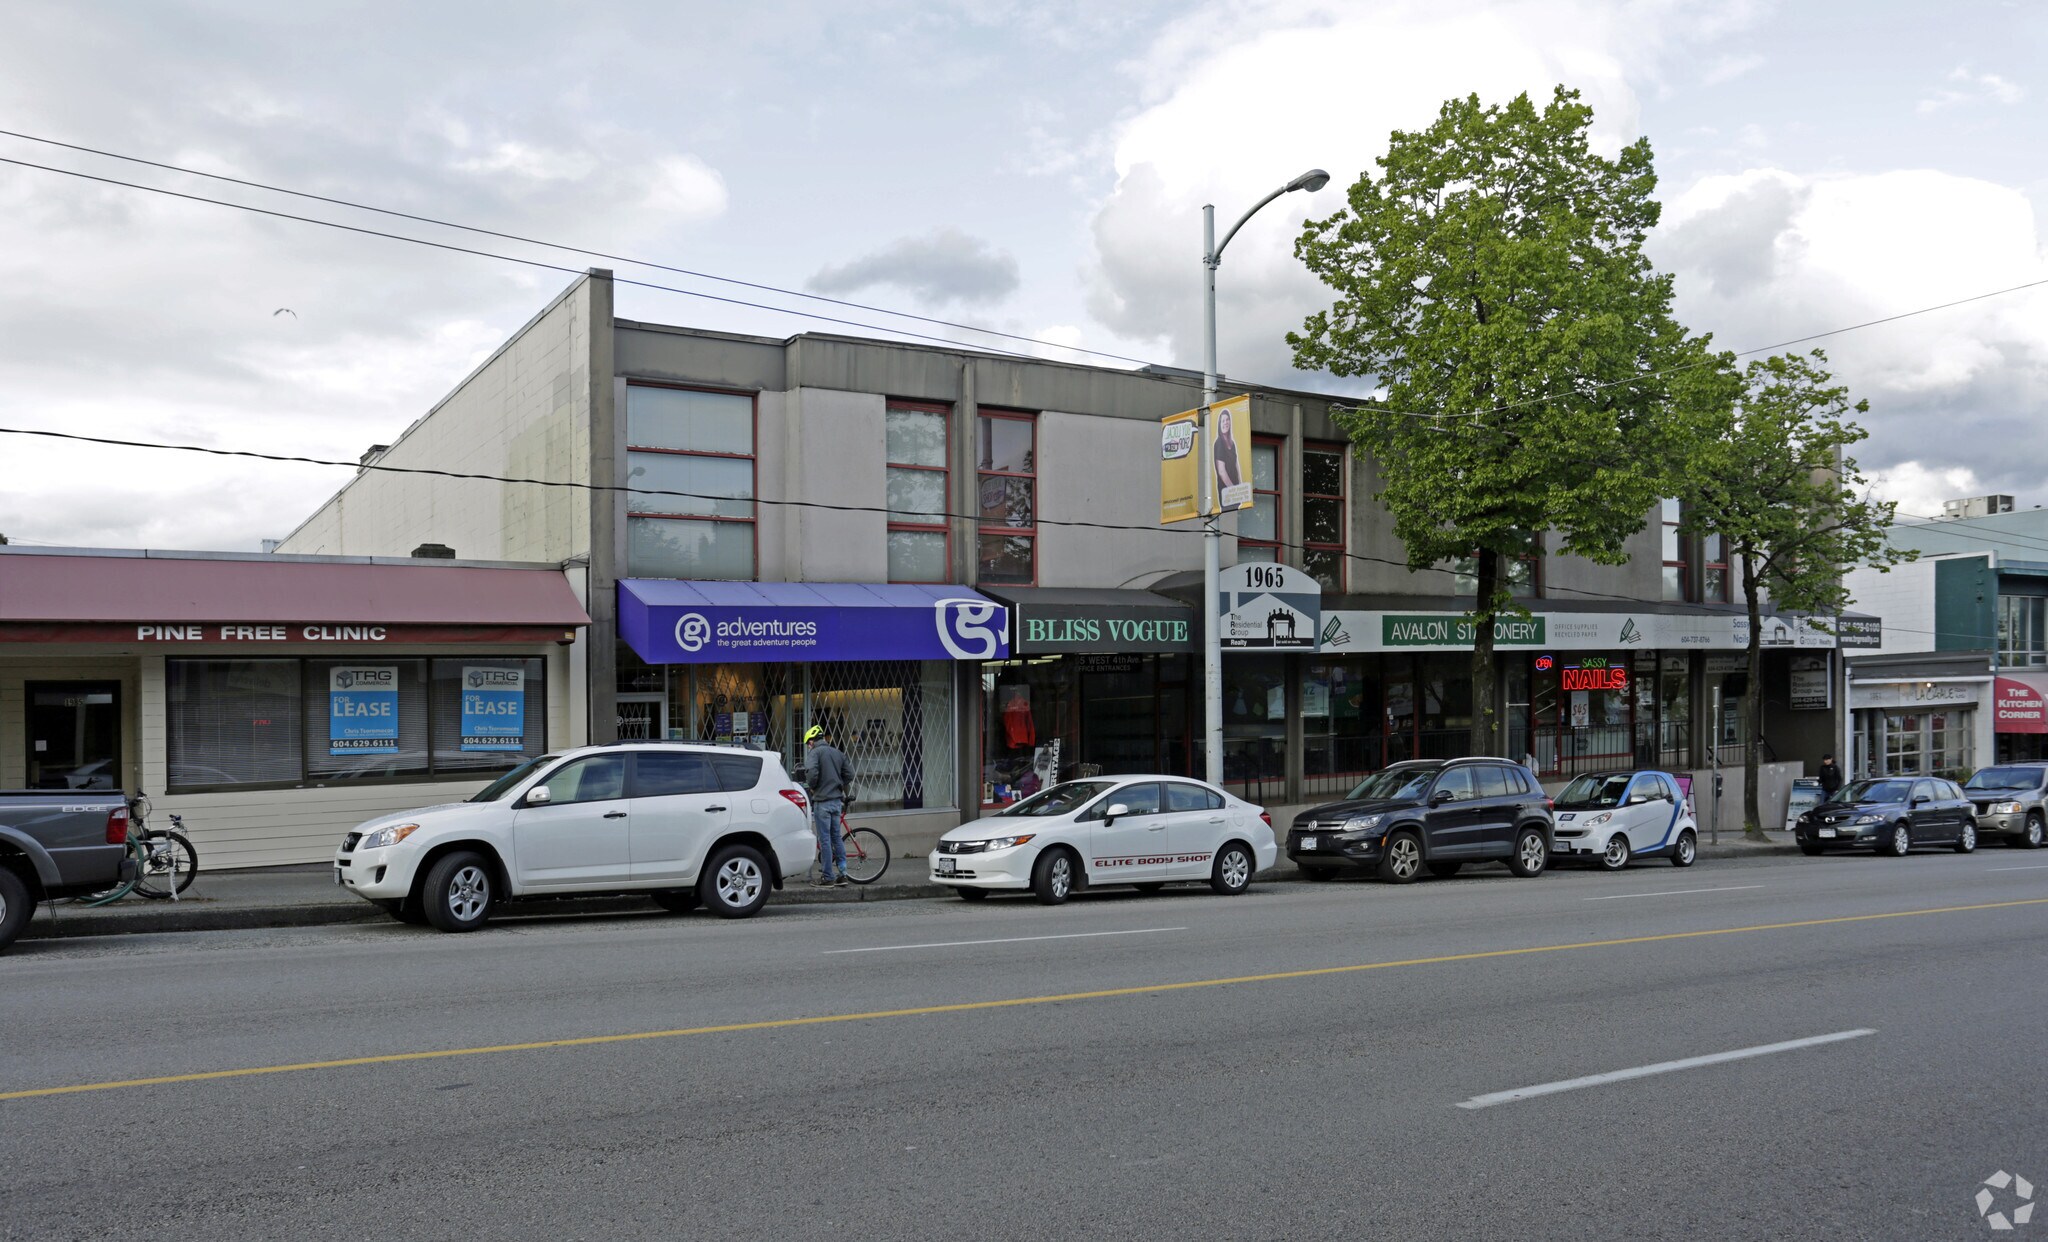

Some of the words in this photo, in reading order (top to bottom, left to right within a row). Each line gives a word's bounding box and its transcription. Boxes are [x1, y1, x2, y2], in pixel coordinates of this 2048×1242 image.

[1246, 567, 1284, 588] 1965
[717, 616, 817, 636] adventures
[1732, 618, 1750, 630] Sassy
[137, 626, 203, 640] PINE
[220, 626, 287, 640] FREE
[302, 626, 387, 640] CLINIC
[1026, 617, 1100, 642] BLISS
[1106, 619, 1188, 642] VOGUE
[1391, 620, 1448, 640] AVALON
[1456, 622, 1537, 640] STONERY
[731, 640, 752, 648] great
[752, 638, 790, 646] adventure
[791, 638, 817, 648] people
[1732, 634, 1750, 644] Nails
[1800, 636, 1818, 646] Group
[1088, 656, 1110, 664] WEST
[1112, 656, 1126, 664] 4th
[1536, 658, 1552, 668] OPEN
[1582, 658, 1607, 668] SASSY
[1078, 664, 1094, 672] FFICE
[1096, 664, 1131, 672] ENTRANCES
[352, 670, 392, 680] TRG
[482, 670, 518, 681] TRG
[1563, 669, 1627, 690] NAILS
[2007, 688, 2029, 697] THE
[334, 702, 391, 716] LEASE
[465, 701, 517, 715] LEASE
[1998, 700, 2042, 708] KITCHEN
[1998, 710, 2040, 719] CORNER
[332, 740, 394, 748] 604.629.6111
[1094, 858, 1134, 868] ELITE
[1138, 857, 1173, 866] BODY
[1176, 854, 1212, 864] SHOP
